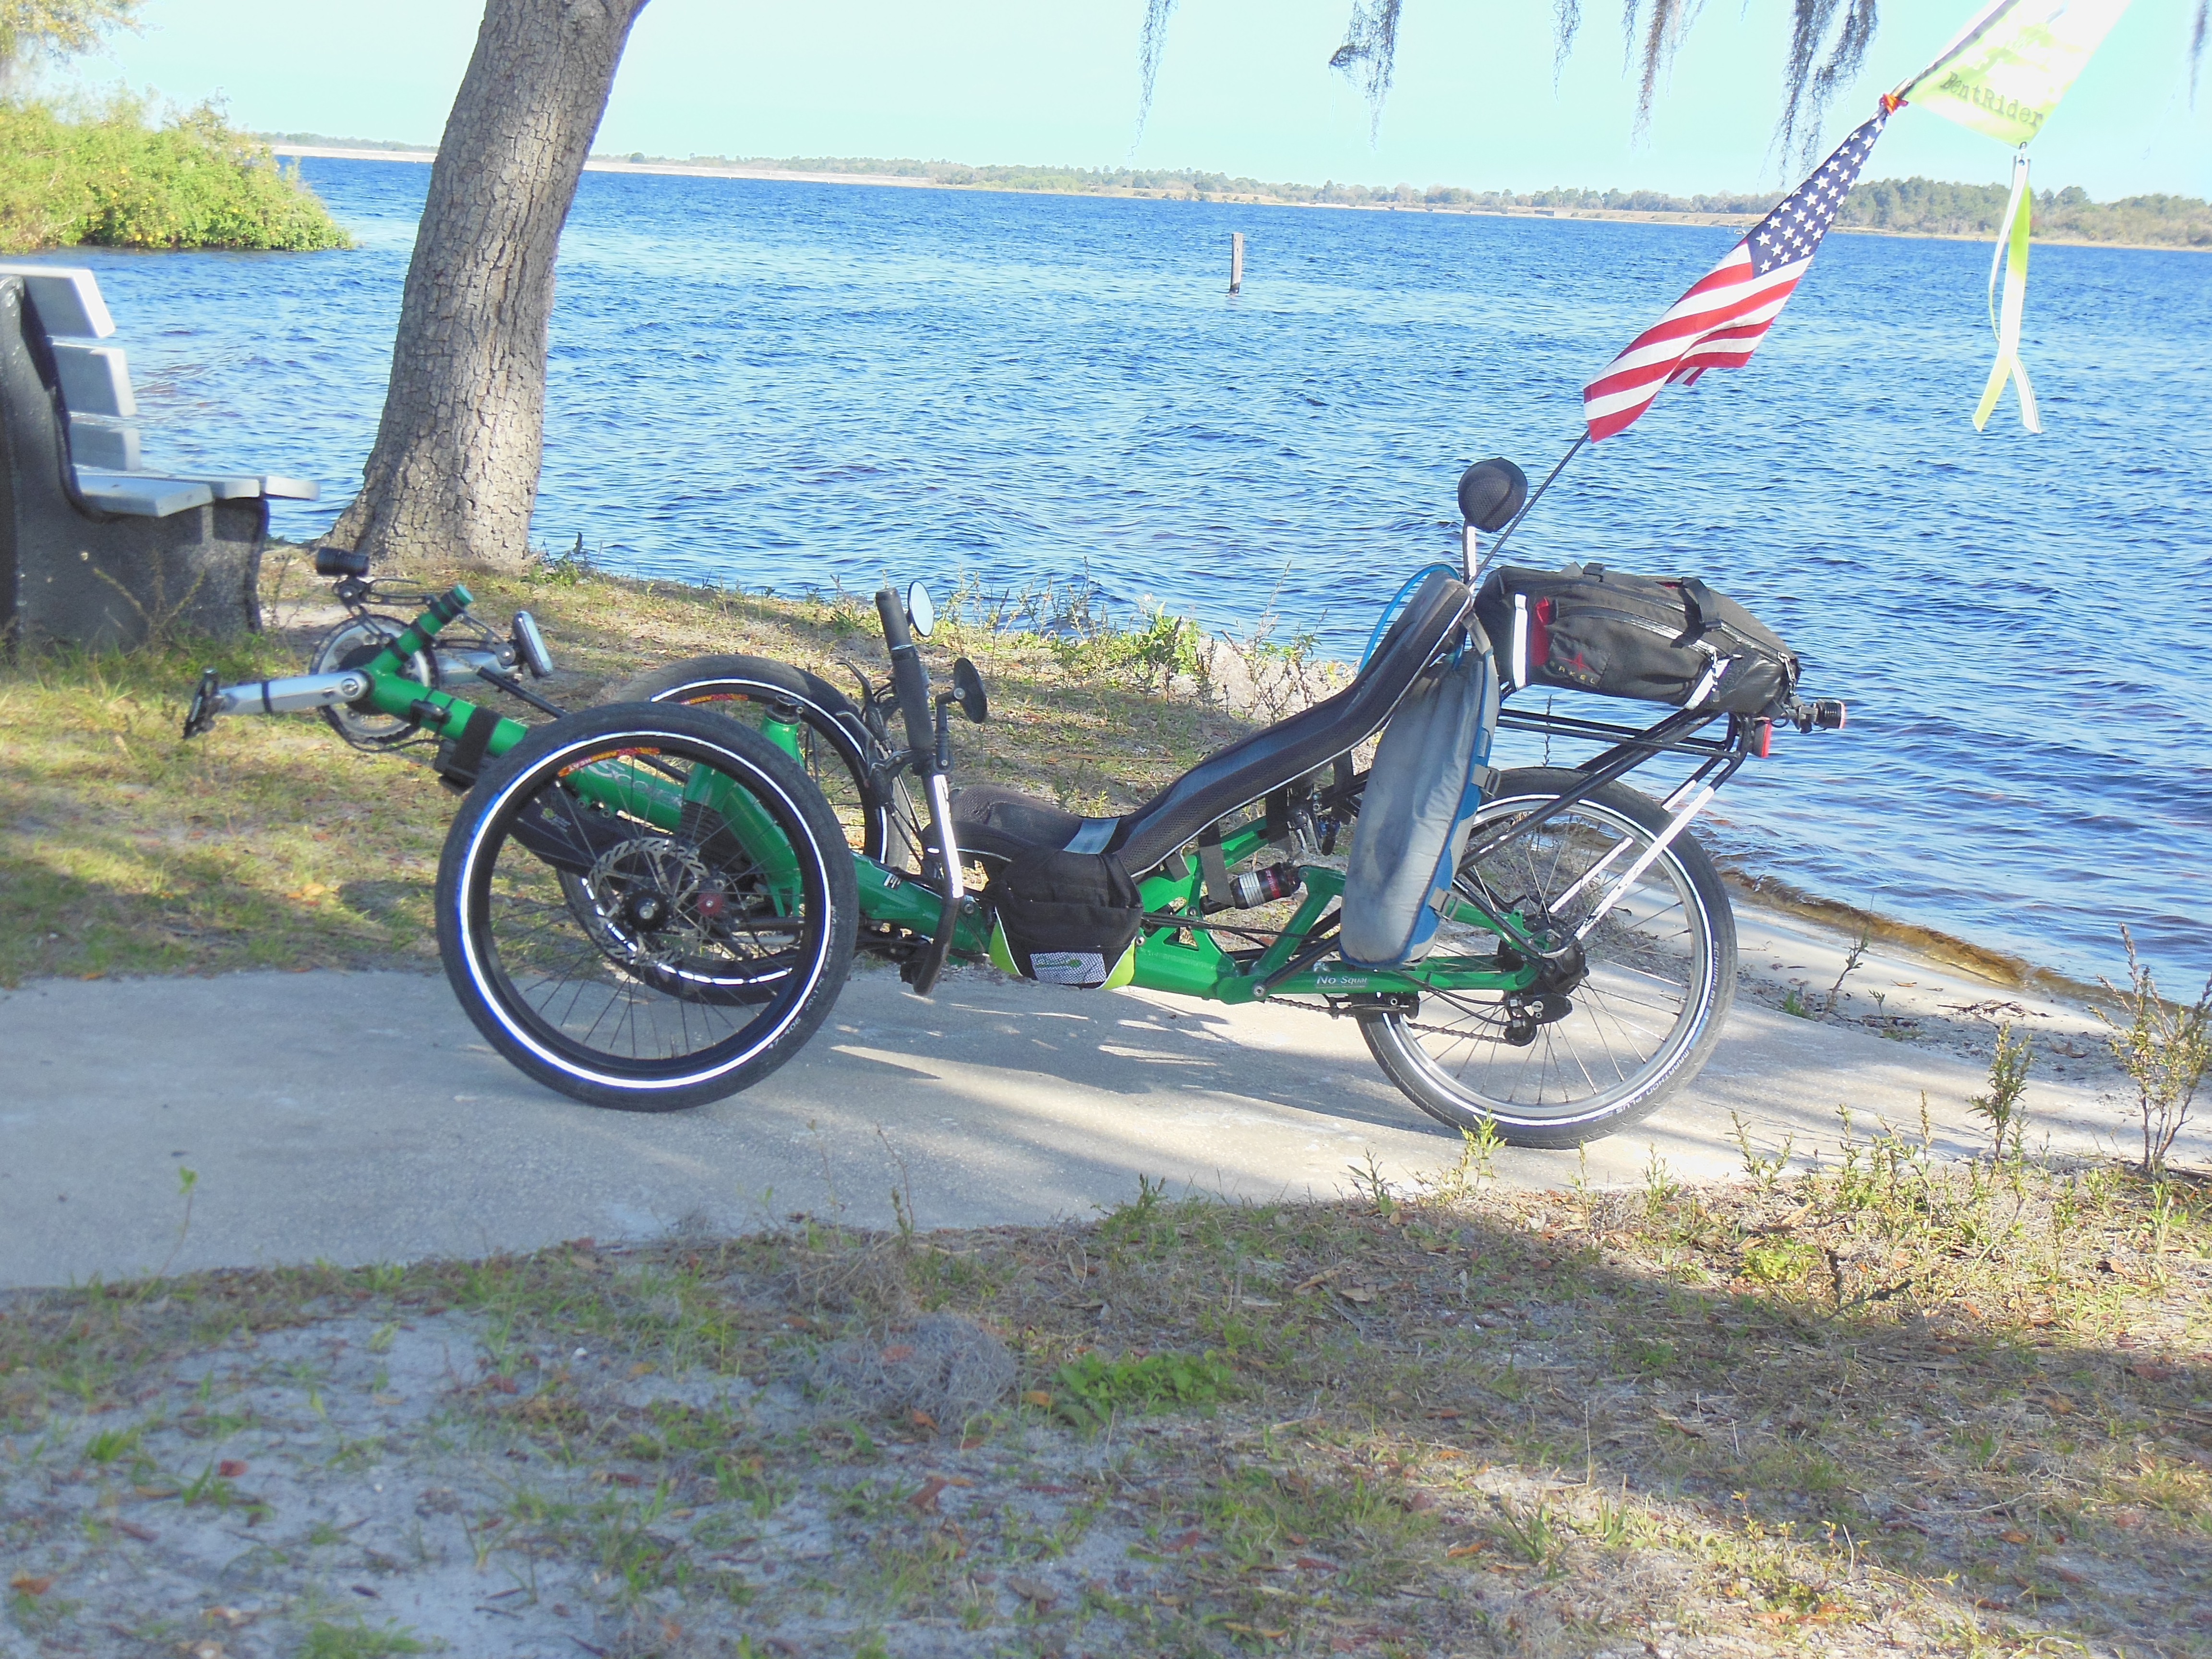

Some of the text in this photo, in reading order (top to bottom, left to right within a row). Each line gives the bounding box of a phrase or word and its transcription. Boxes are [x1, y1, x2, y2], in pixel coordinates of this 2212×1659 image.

[1940, 71, 2043, 127] BentRider
[1317, 975, 1336, 984] No
[1646, 1049, 1690, 1095] MARATHON
[1615, 1095, 1642, 1114] PLUS
